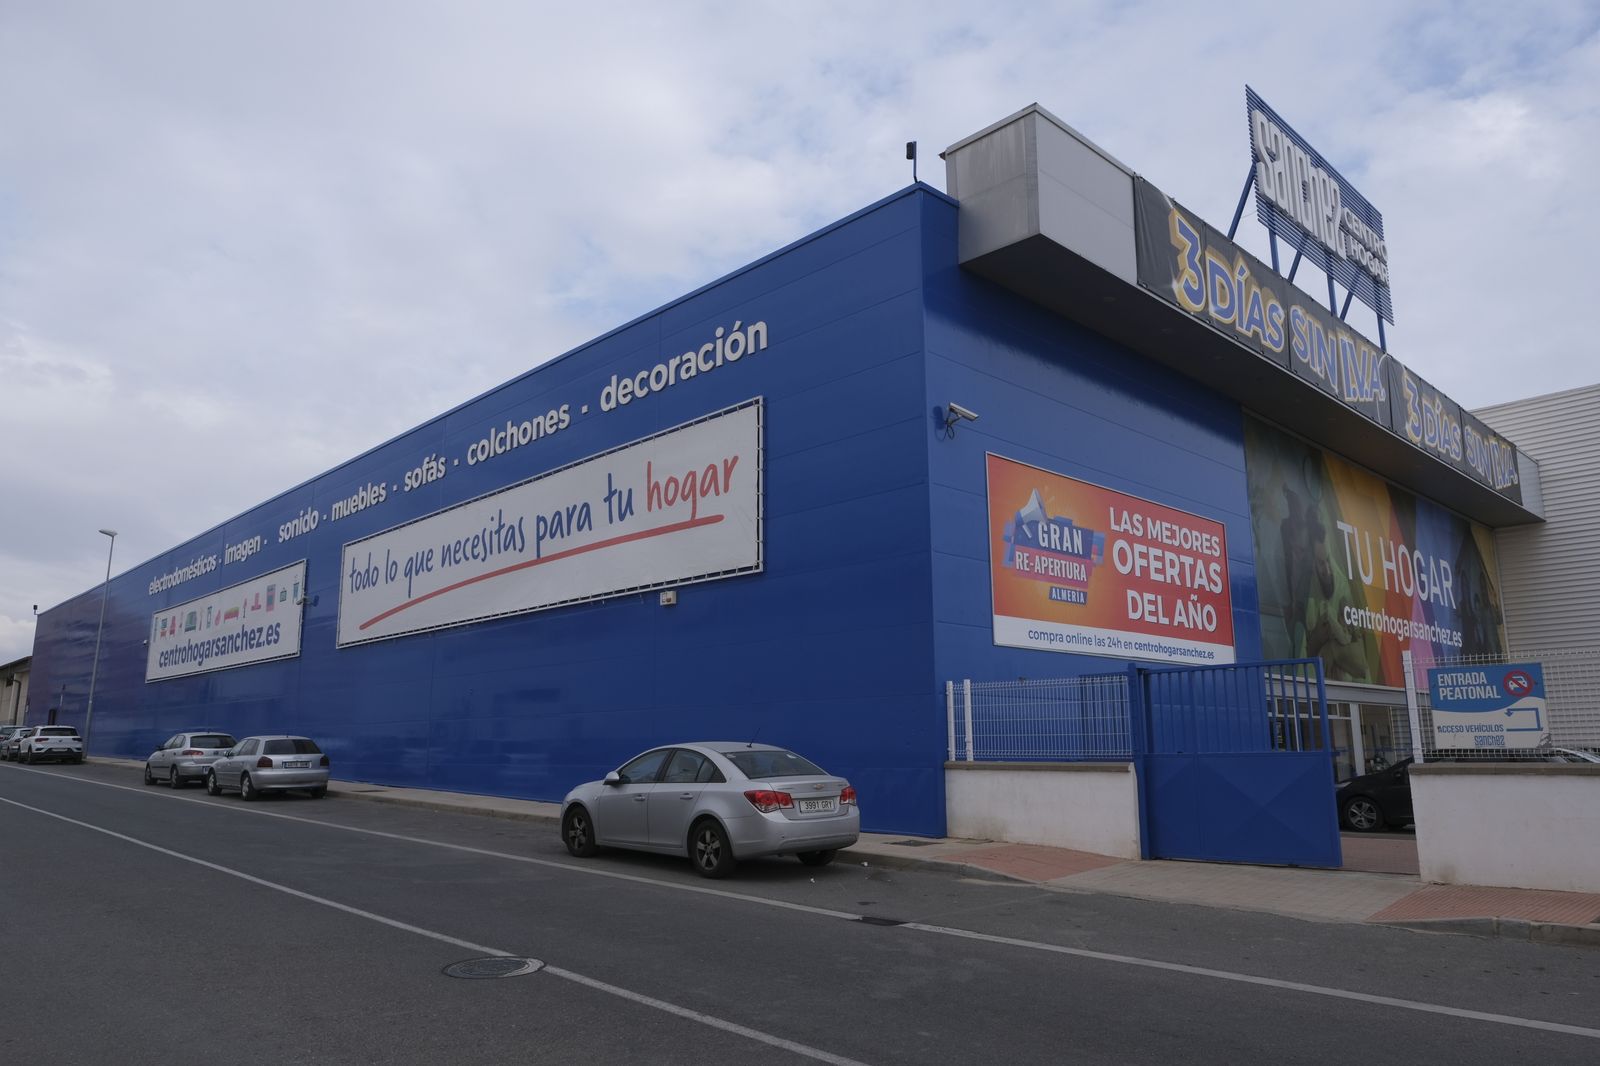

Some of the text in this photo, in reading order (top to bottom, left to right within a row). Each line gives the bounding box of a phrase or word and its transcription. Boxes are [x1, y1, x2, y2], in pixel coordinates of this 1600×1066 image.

[1341, 206, 1389, 265] CENTRO
[1345, 237, 1391, 290] HOGAR
[1169, 207, 1206, 313] 3
[1204, 249, 1286, 352] DÍAS
[1290, 305, 1339, 394] SIN
[1403, 374, 1422, 444] 3
[148, 320, 768, 596] electrodomésticos imagen sonido muebles sofás colchones decoración
[349, 455, 739, 599] todo lo que necesitas para tu hogar
[1037, 521, 1083, 555] GRAN
[1109, 507, 1221, 558] LAS MEJORES
[1015, 551, 1088, 582] RE-APERTURA
[1112, 539, 1223, 594] OFERTAS
[1336, 520, 1457, 610] TU HOGAR
[1127, 589, 1217, 633] DEL AÑO
[1343, 605, 1464, 648] centrohogarsanchez.es
[158, 621, 281, 669] centrohogarsanchez.es
[1028, 629, 1215, 660] compra online las 24h en centrohogarsanchez.es
[1437, 672, 1487, 687] ENTRADA
[1439, 685, 1501, 701] PEATONAL
